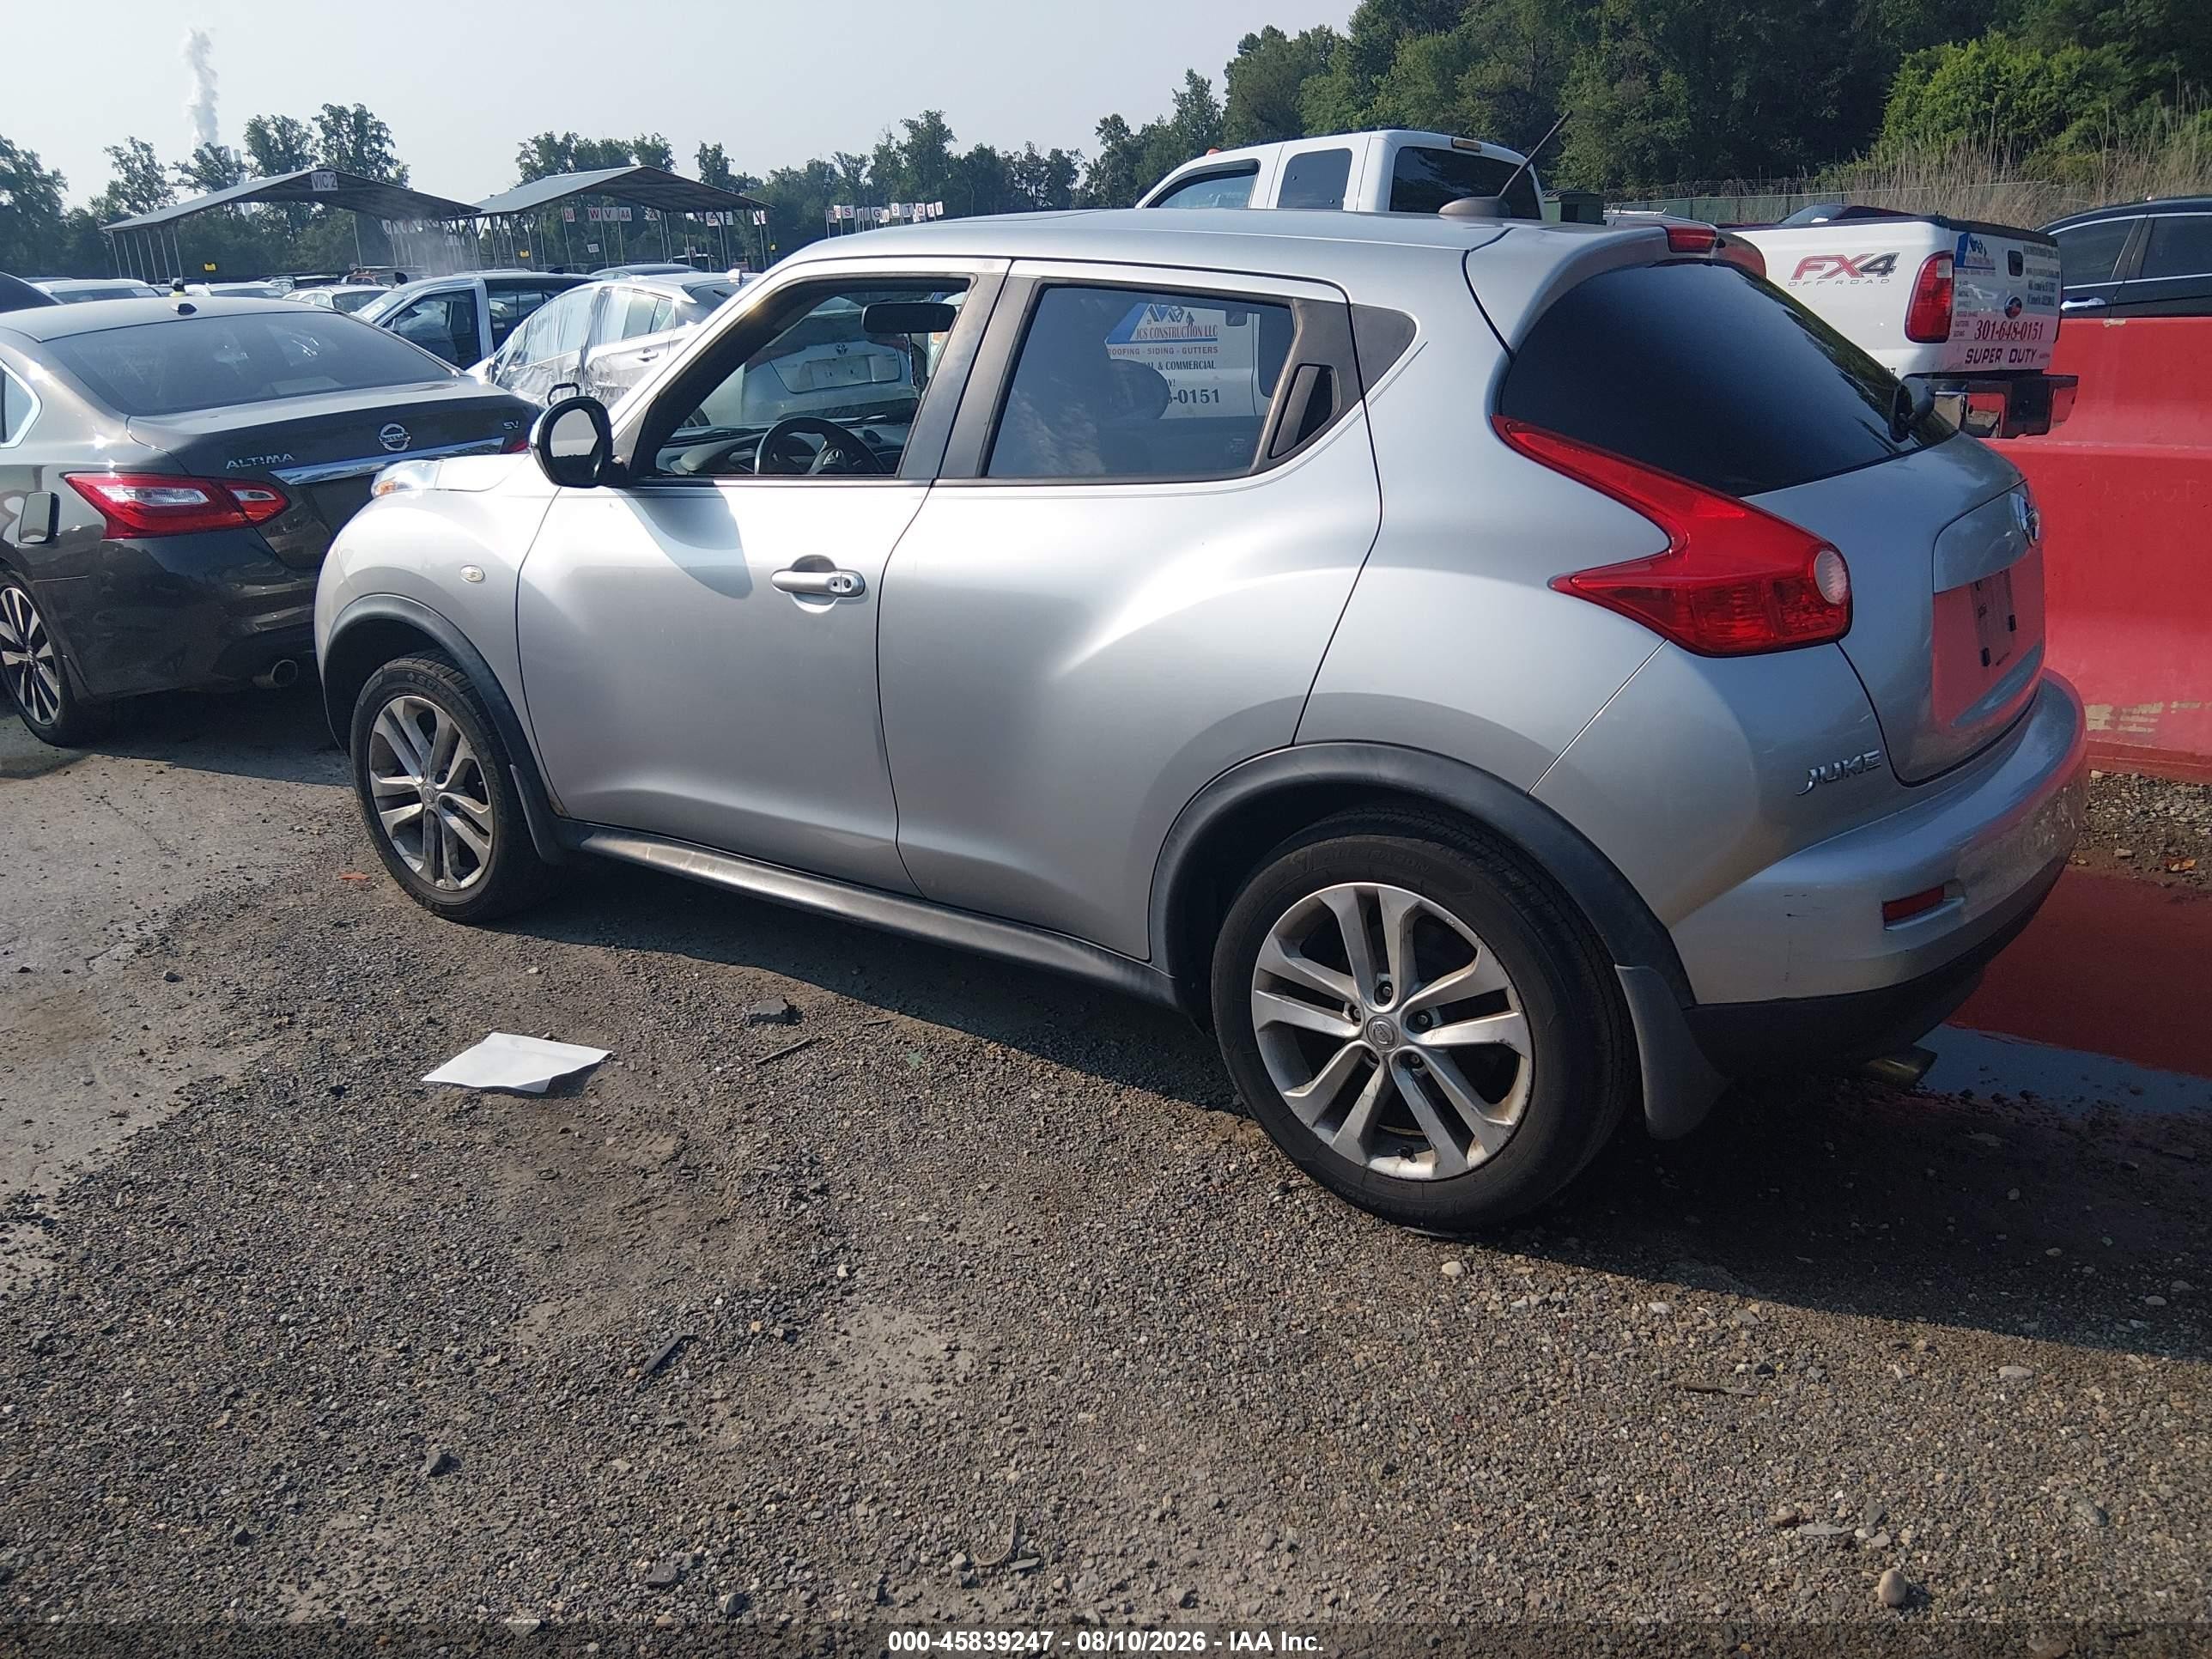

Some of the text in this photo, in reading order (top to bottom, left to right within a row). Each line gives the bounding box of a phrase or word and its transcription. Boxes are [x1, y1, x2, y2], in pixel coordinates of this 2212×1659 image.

[312, 174, 337, 188] VIC 2
[1790, 252, 1900, 280] FX4
[1136, 325, 1218, 340] JCS CONSTRUCTION LLC
[1974, 319, 2044, 341] 301-648-0151
[1182, 346, 1218, 355] GUTTERS
[1965, 348, 2002, 364] SUPER
[2008, 348, 2038, 363] DUTY
[1158, 362, 1164, 370] &
[1165, 360, 1217, 370] COMMERCIAL
[502, 420, 520, 429] SV
[226, 453, 296, 470] ALTIMA
[1794, 749, 1881, 796] JUKE
